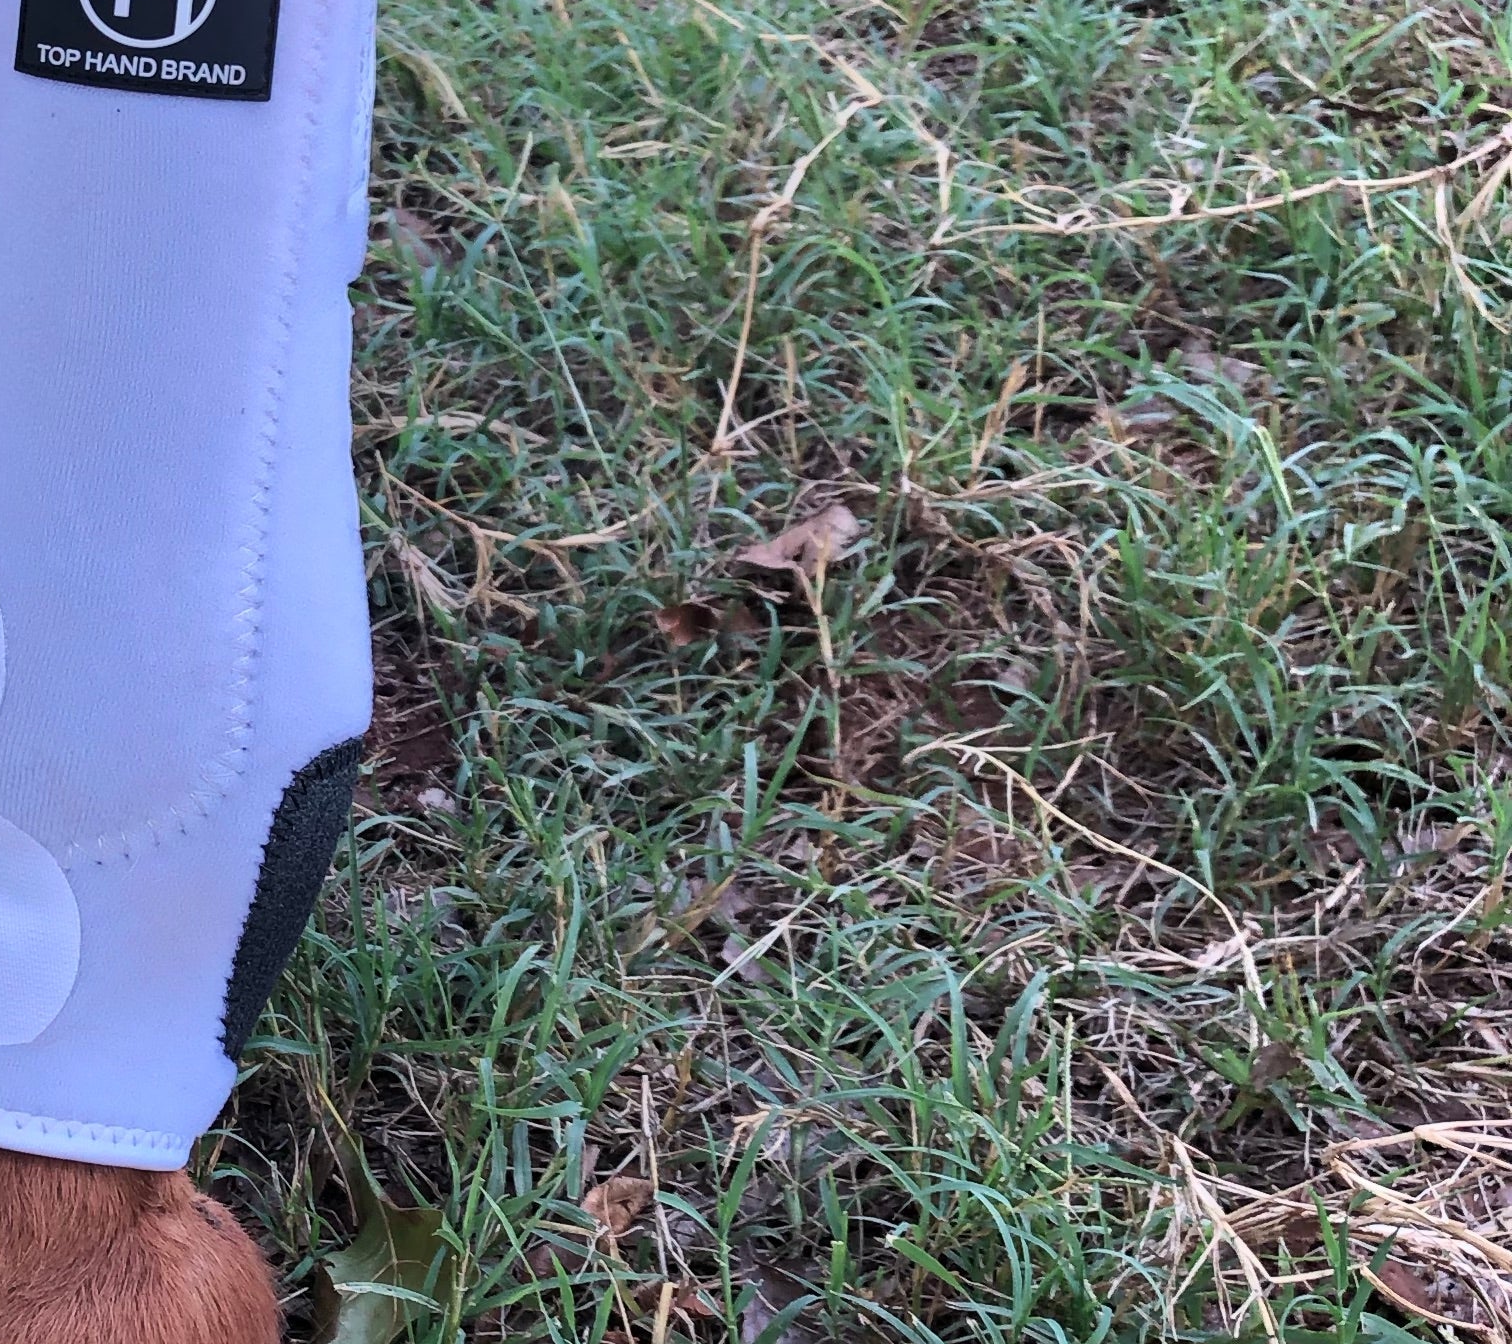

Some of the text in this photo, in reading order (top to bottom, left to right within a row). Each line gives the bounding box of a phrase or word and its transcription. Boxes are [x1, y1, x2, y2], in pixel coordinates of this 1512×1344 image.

[37, 43, 246, 86] TOP HAND BRAND
